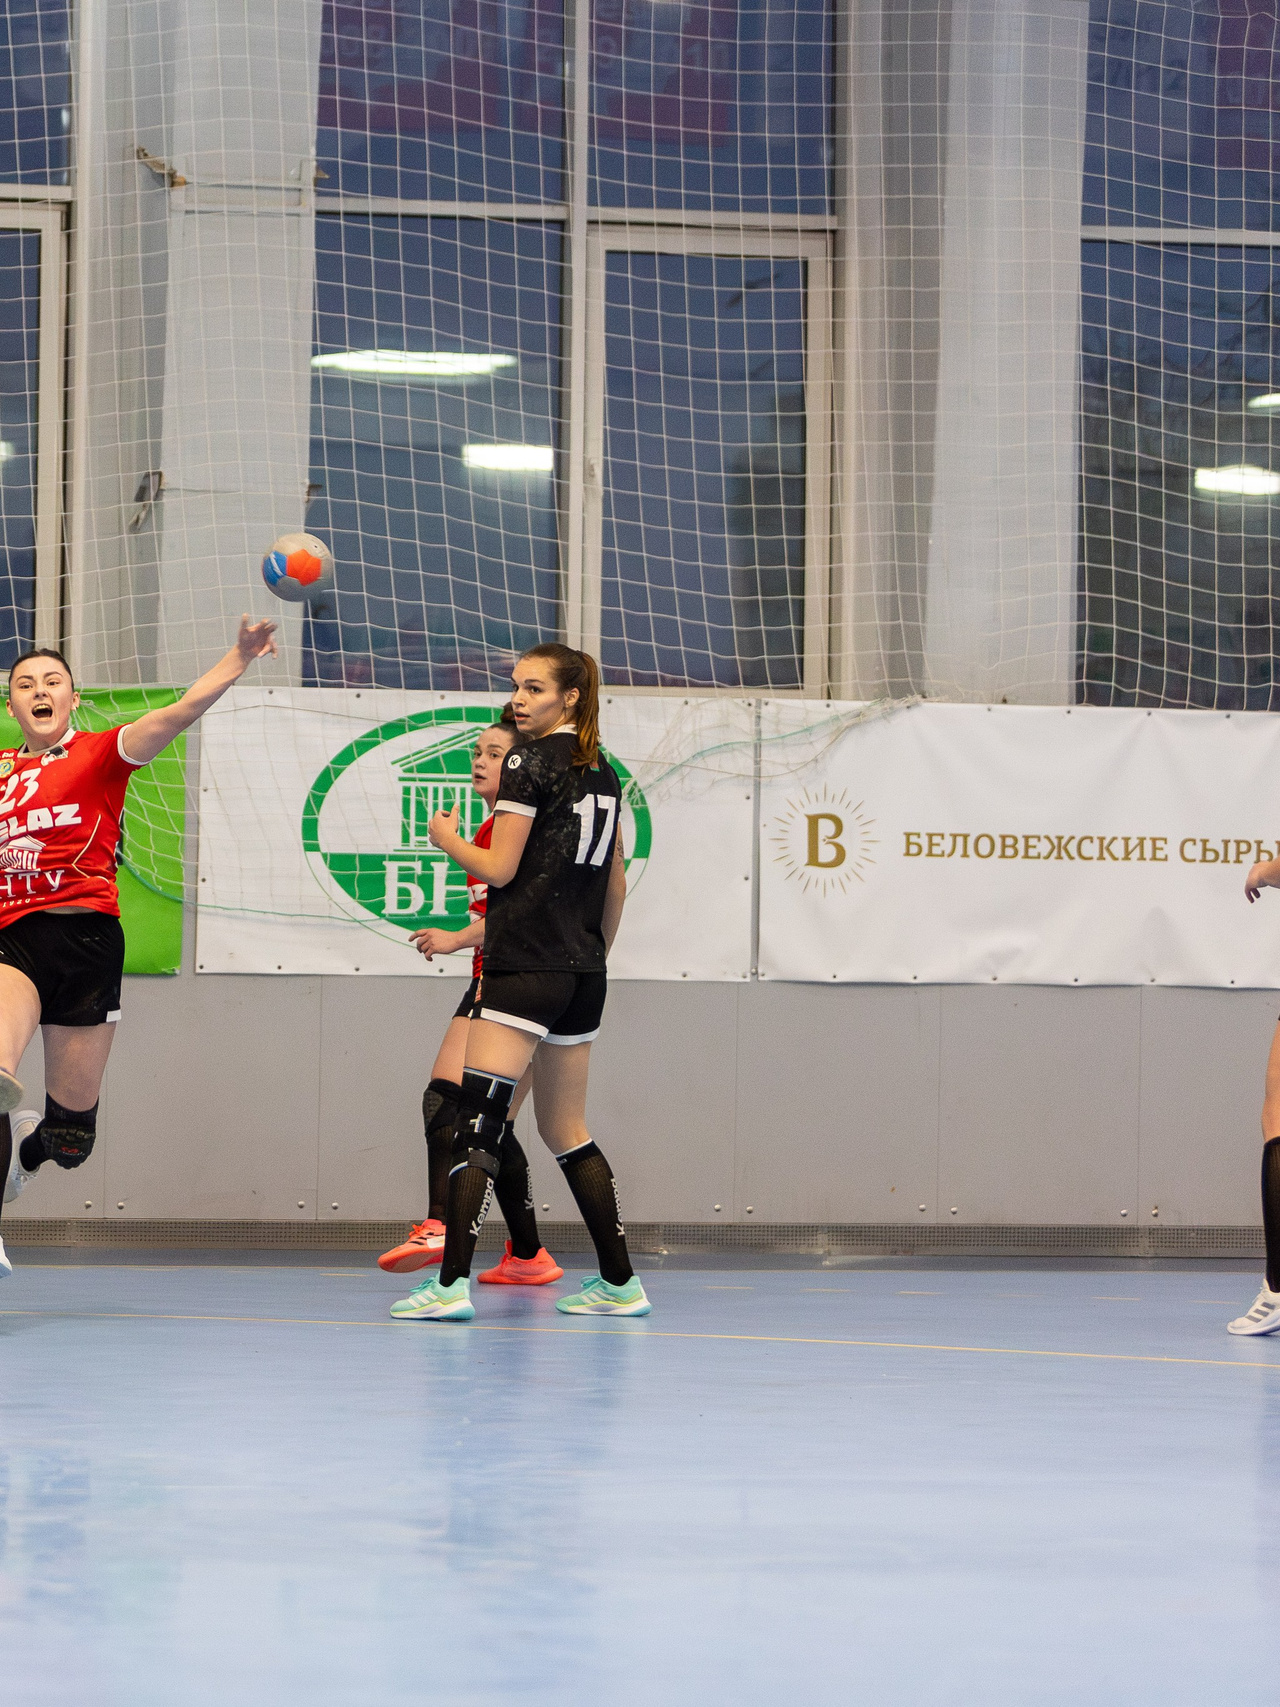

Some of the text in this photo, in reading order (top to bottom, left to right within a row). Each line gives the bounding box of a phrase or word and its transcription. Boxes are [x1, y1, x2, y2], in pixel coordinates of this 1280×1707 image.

[572, 793, 617, 867] 17
[902, 831, 1169, 862] БЕЛОВЕЖСКИЕ
[469, 1176, 495, 1237] Kempa
